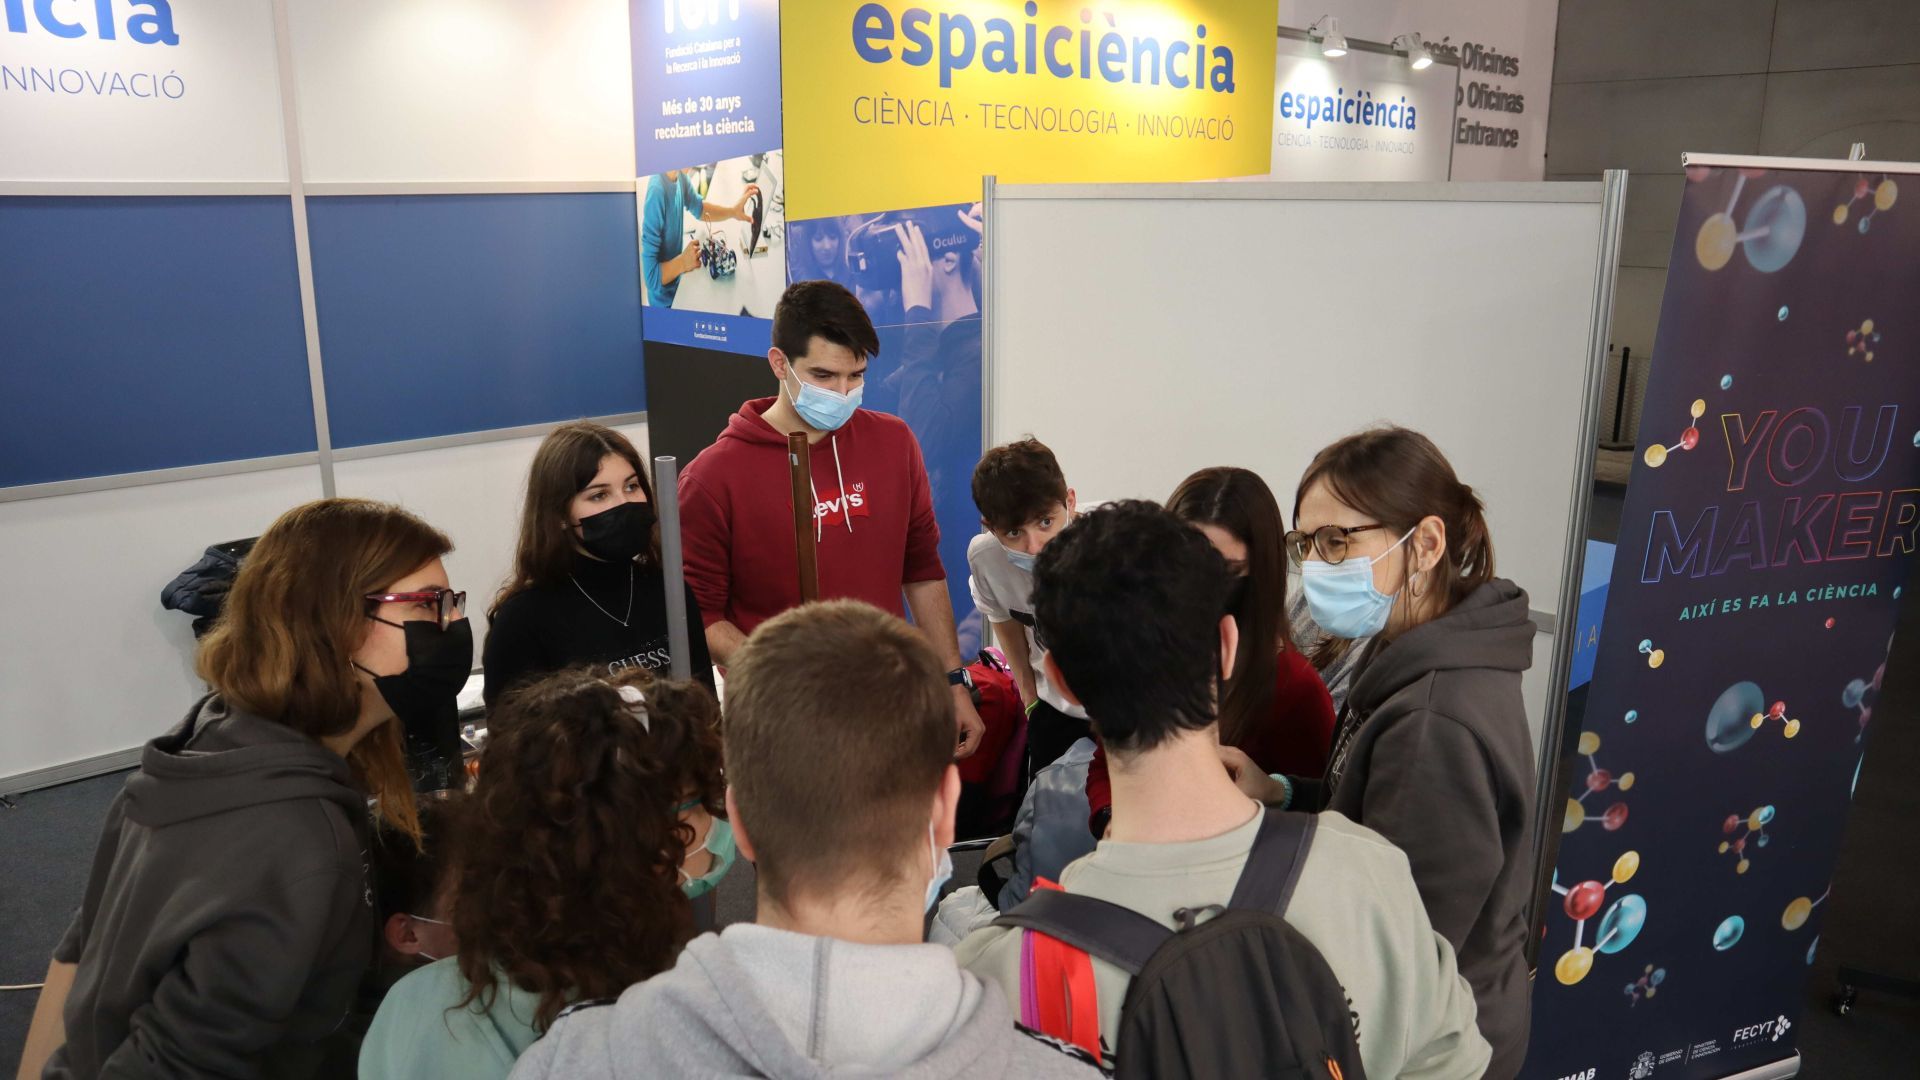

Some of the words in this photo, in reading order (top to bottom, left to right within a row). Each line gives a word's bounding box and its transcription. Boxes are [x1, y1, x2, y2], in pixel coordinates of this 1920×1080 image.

[851, 0, 1236, 94] espaiciència
[1461, 41, 1520, 77] Oficines
[662, 98, 682, 116] Més
[684, 97, 698, 114] de
[700, 96, 713, 112] 30
[715, 95, 742, 114] anys
[1280, 87, 1416, 131] espaiciència
[1467, 81, 1525, 114] Oficinas
[655, 121, 702, 140] recolzant
[703, 119, 714, 136] la
[715, 116, 755, 135] ciència
[854, 91, 954, 127] CIÈNCIA
[979, 103, 1118, 135] TECNOLOGIA
[1137, 113, 1234, 141] INNOVACIÓ
[1456, 117, 1520, 148] Entrance
[1320, 135, 1369, 151] TECNOLOGIA
[932, 234, 968, 250] Oculus
[1720, 404, 1899, 492] YOU
[1640, 488, 1920, 583] MAKER
[1678, 598, 1716, 621] AIXÍ
[1721, 597, 1742, 614] ES
[1749, 594, 1770, 609] FA
[1777, 590, 1798, 606] LA
[1806, 582, 1879, 602] CIÈNCIA
[1733, 1020, 1775, 1043] FECYT
